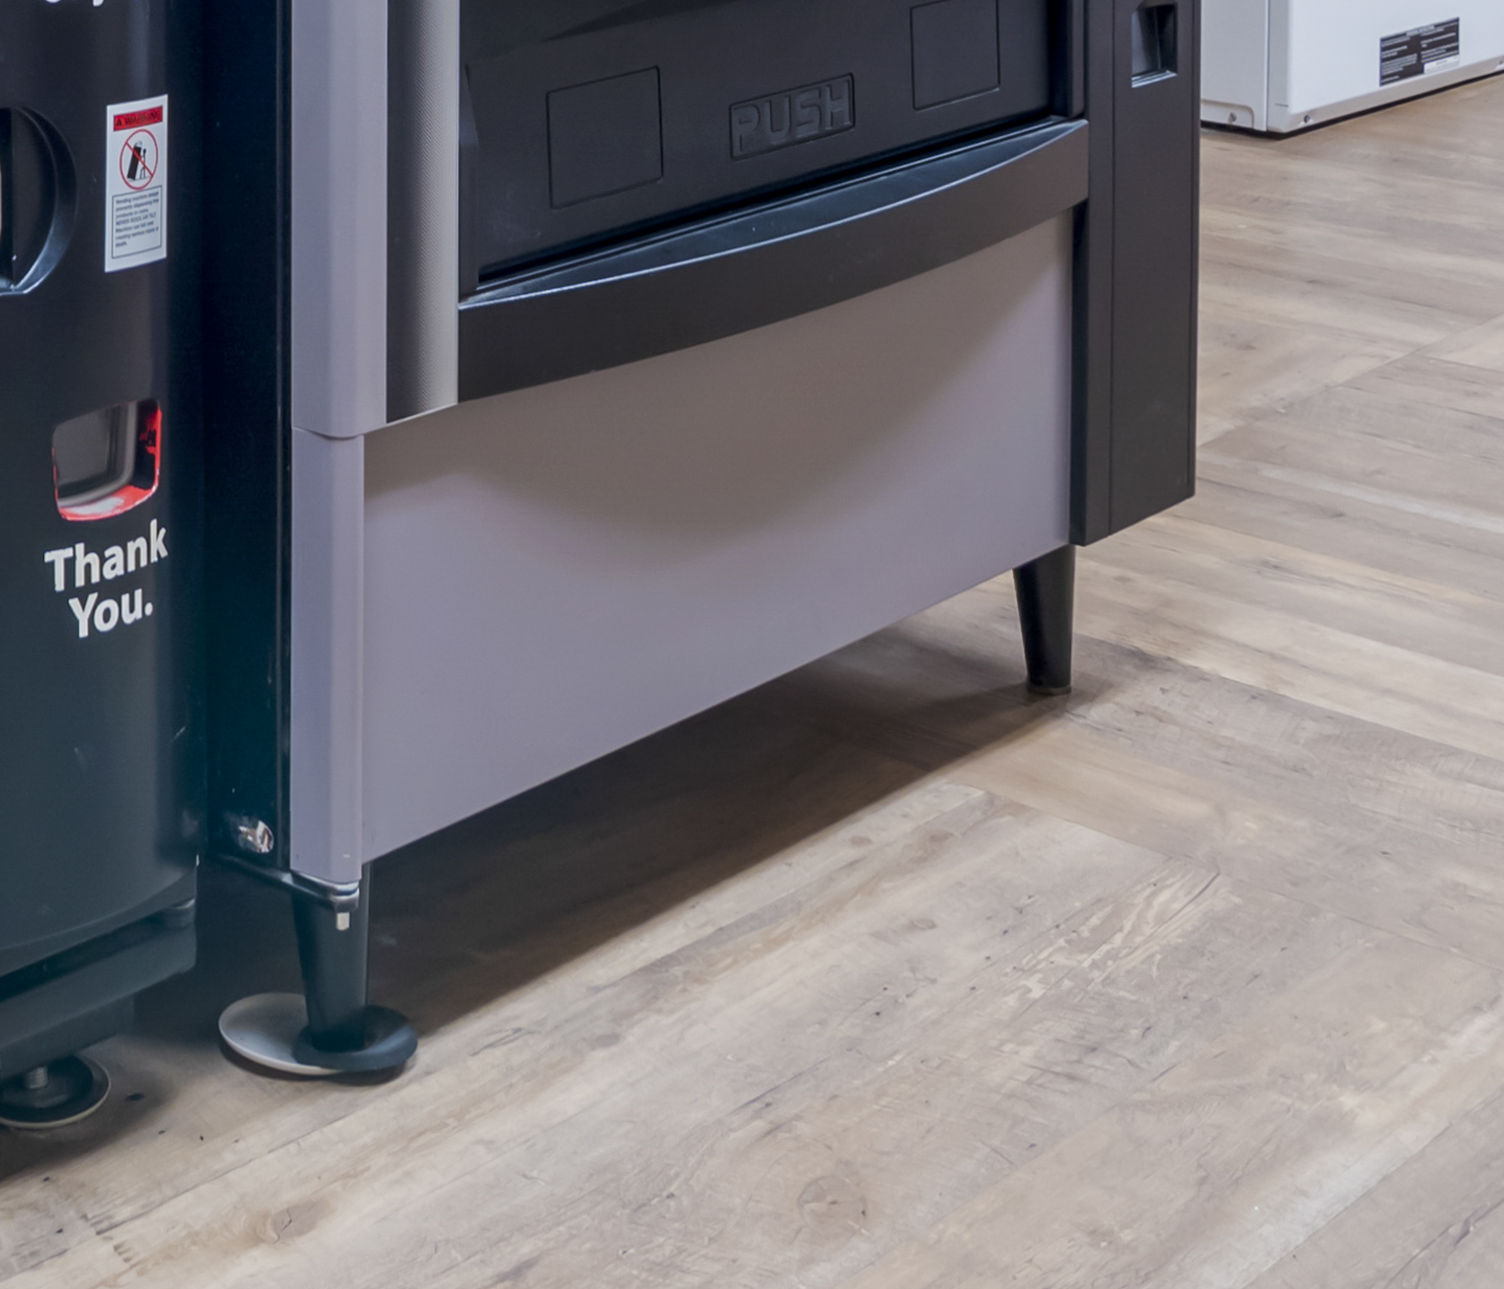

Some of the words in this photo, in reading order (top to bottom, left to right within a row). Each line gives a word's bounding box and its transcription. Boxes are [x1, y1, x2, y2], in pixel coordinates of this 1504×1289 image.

[735, 77, 851, 154] PUSH
[44, 518, 169, 594] Thank
[68, 584, 154, 639] You.
